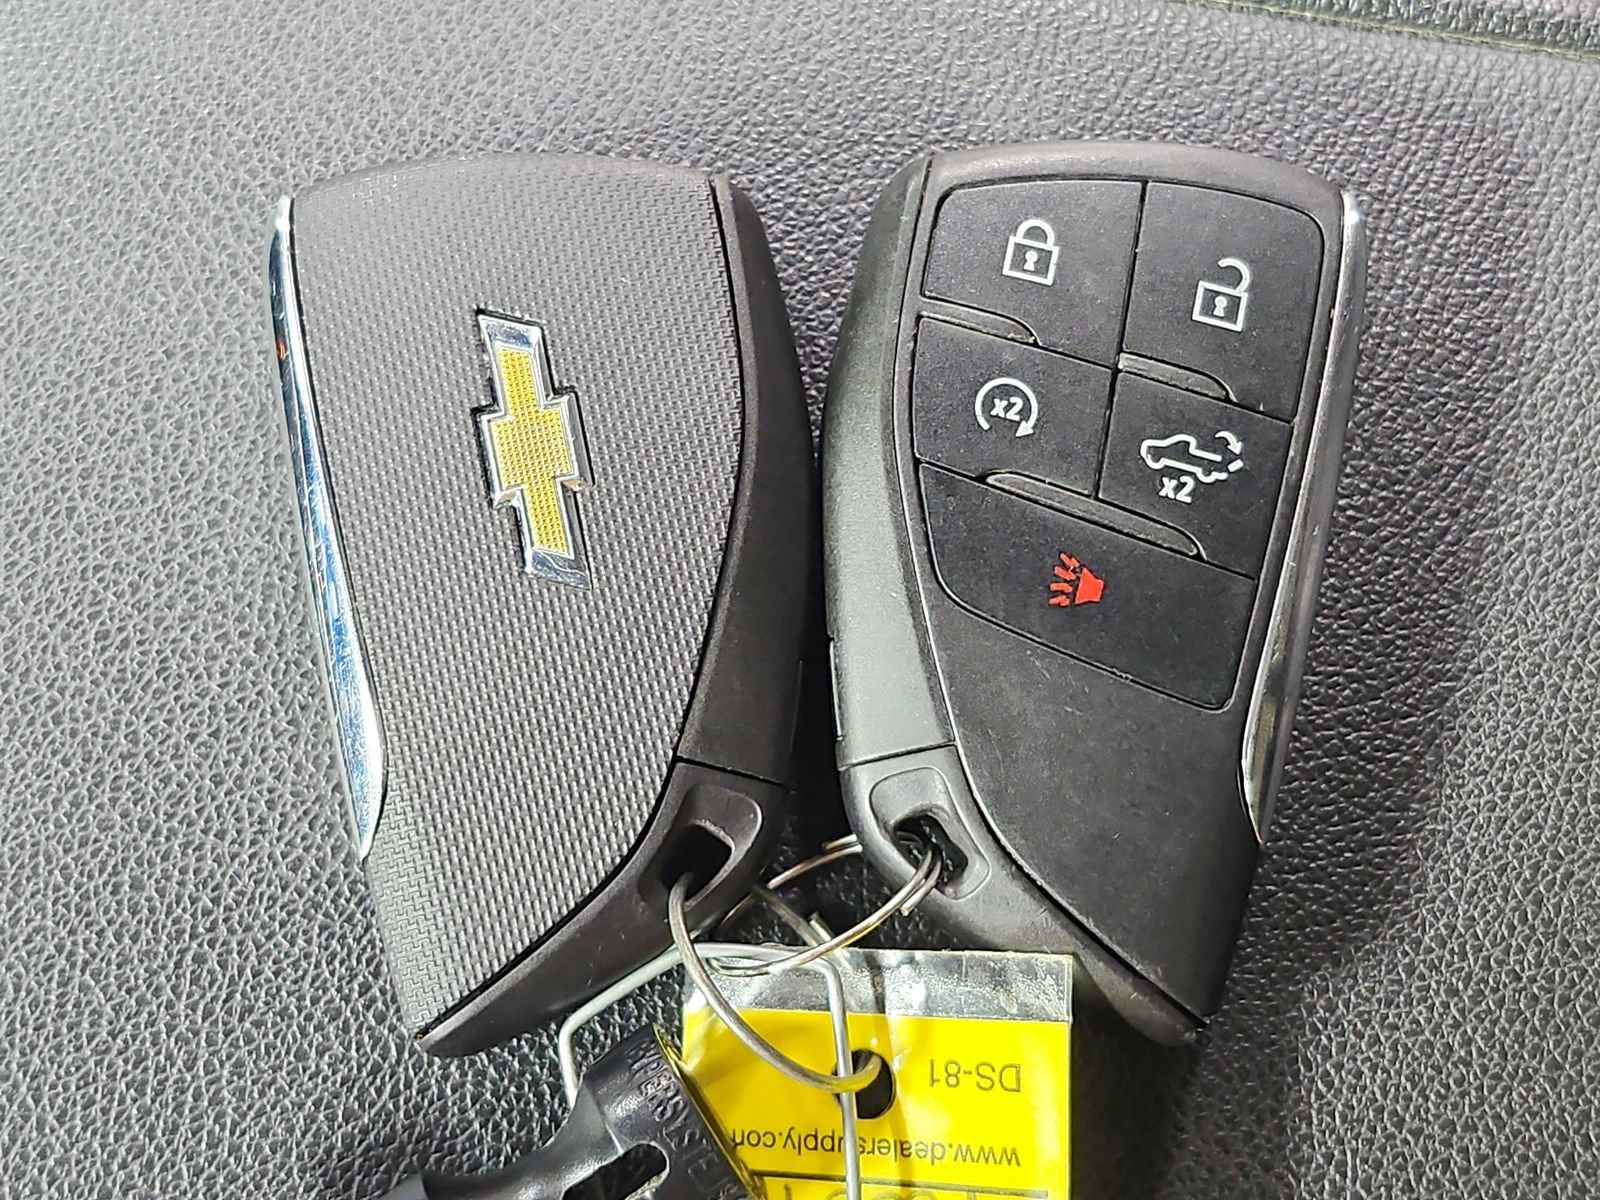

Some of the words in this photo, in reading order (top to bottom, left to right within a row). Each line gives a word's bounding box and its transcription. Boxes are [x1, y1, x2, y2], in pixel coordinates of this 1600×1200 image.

[990, 397, 1024, 421] x2
[1158, 476, 1196, 503] x2
[929, 1059, 1021, 1093] DS-81
